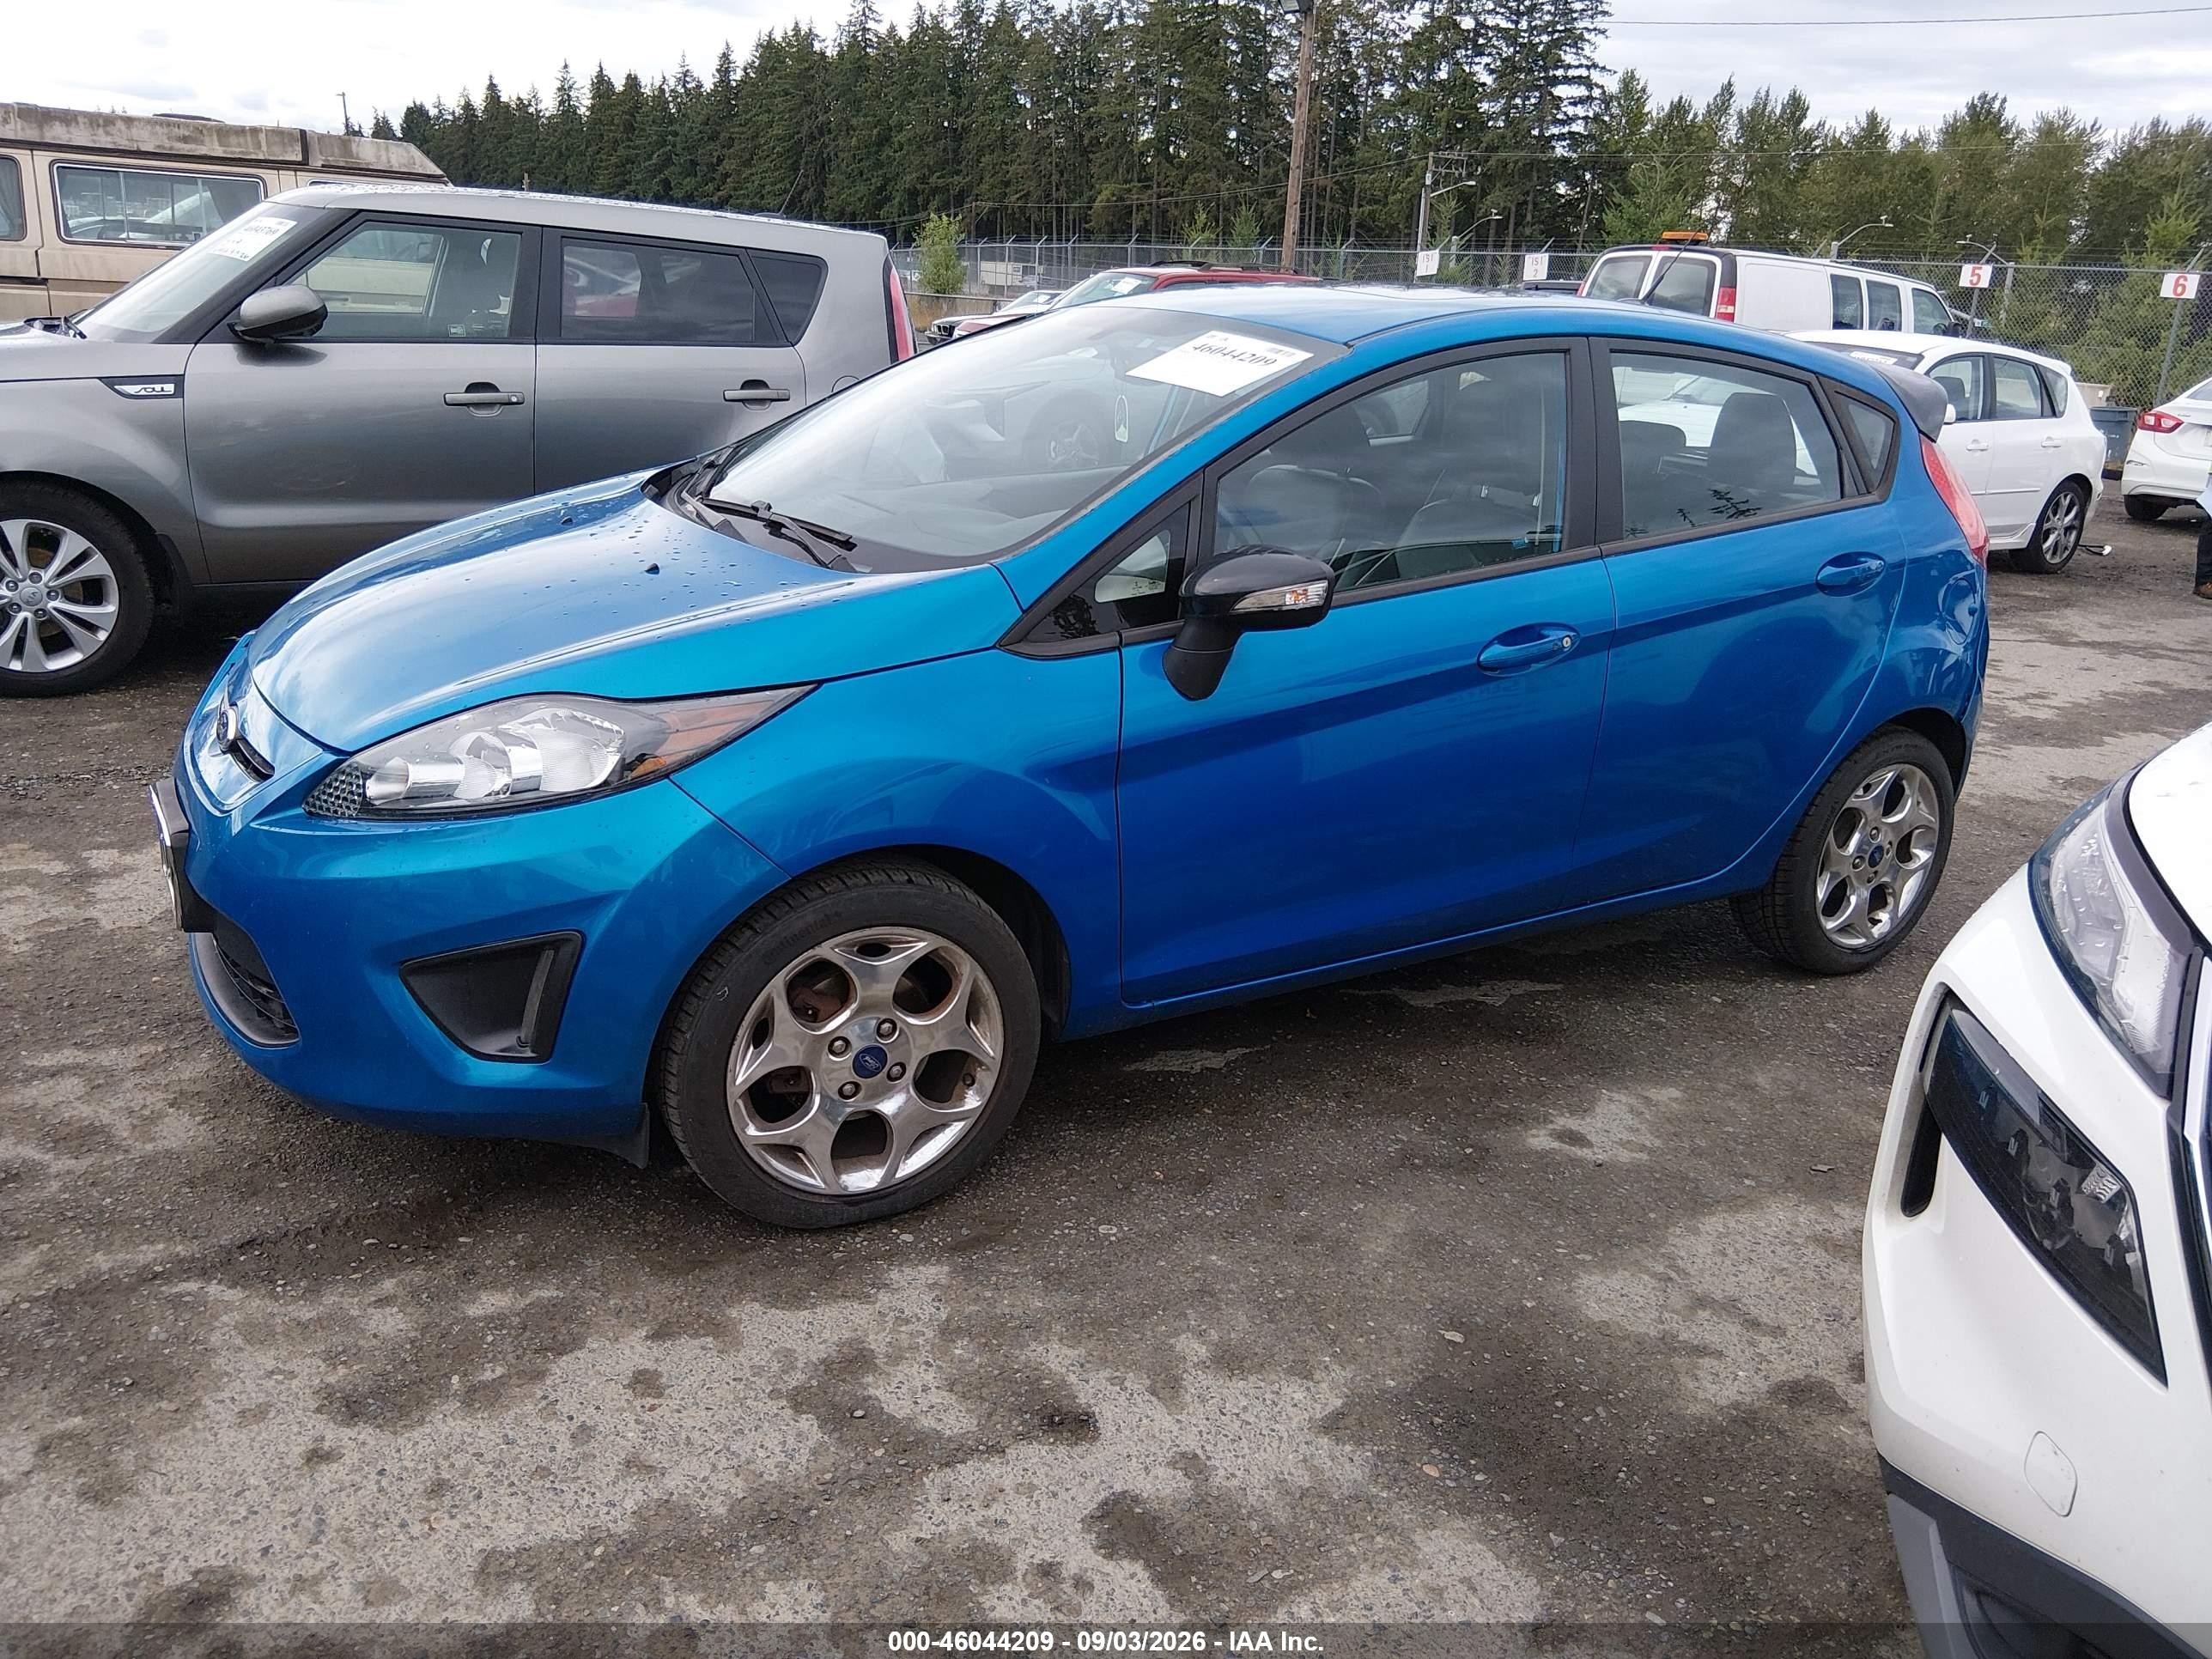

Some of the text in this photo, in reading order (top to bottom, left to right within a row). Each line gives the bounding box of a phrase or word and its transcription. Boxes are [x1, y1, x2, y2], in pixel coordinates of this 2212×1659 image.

[1533, 268, 1539, 278] 2
[1968, 266, 1984, 286] 5
[2172, 275, 2188, 297] 6
[1192, 343, 1278, 367] 46044209
